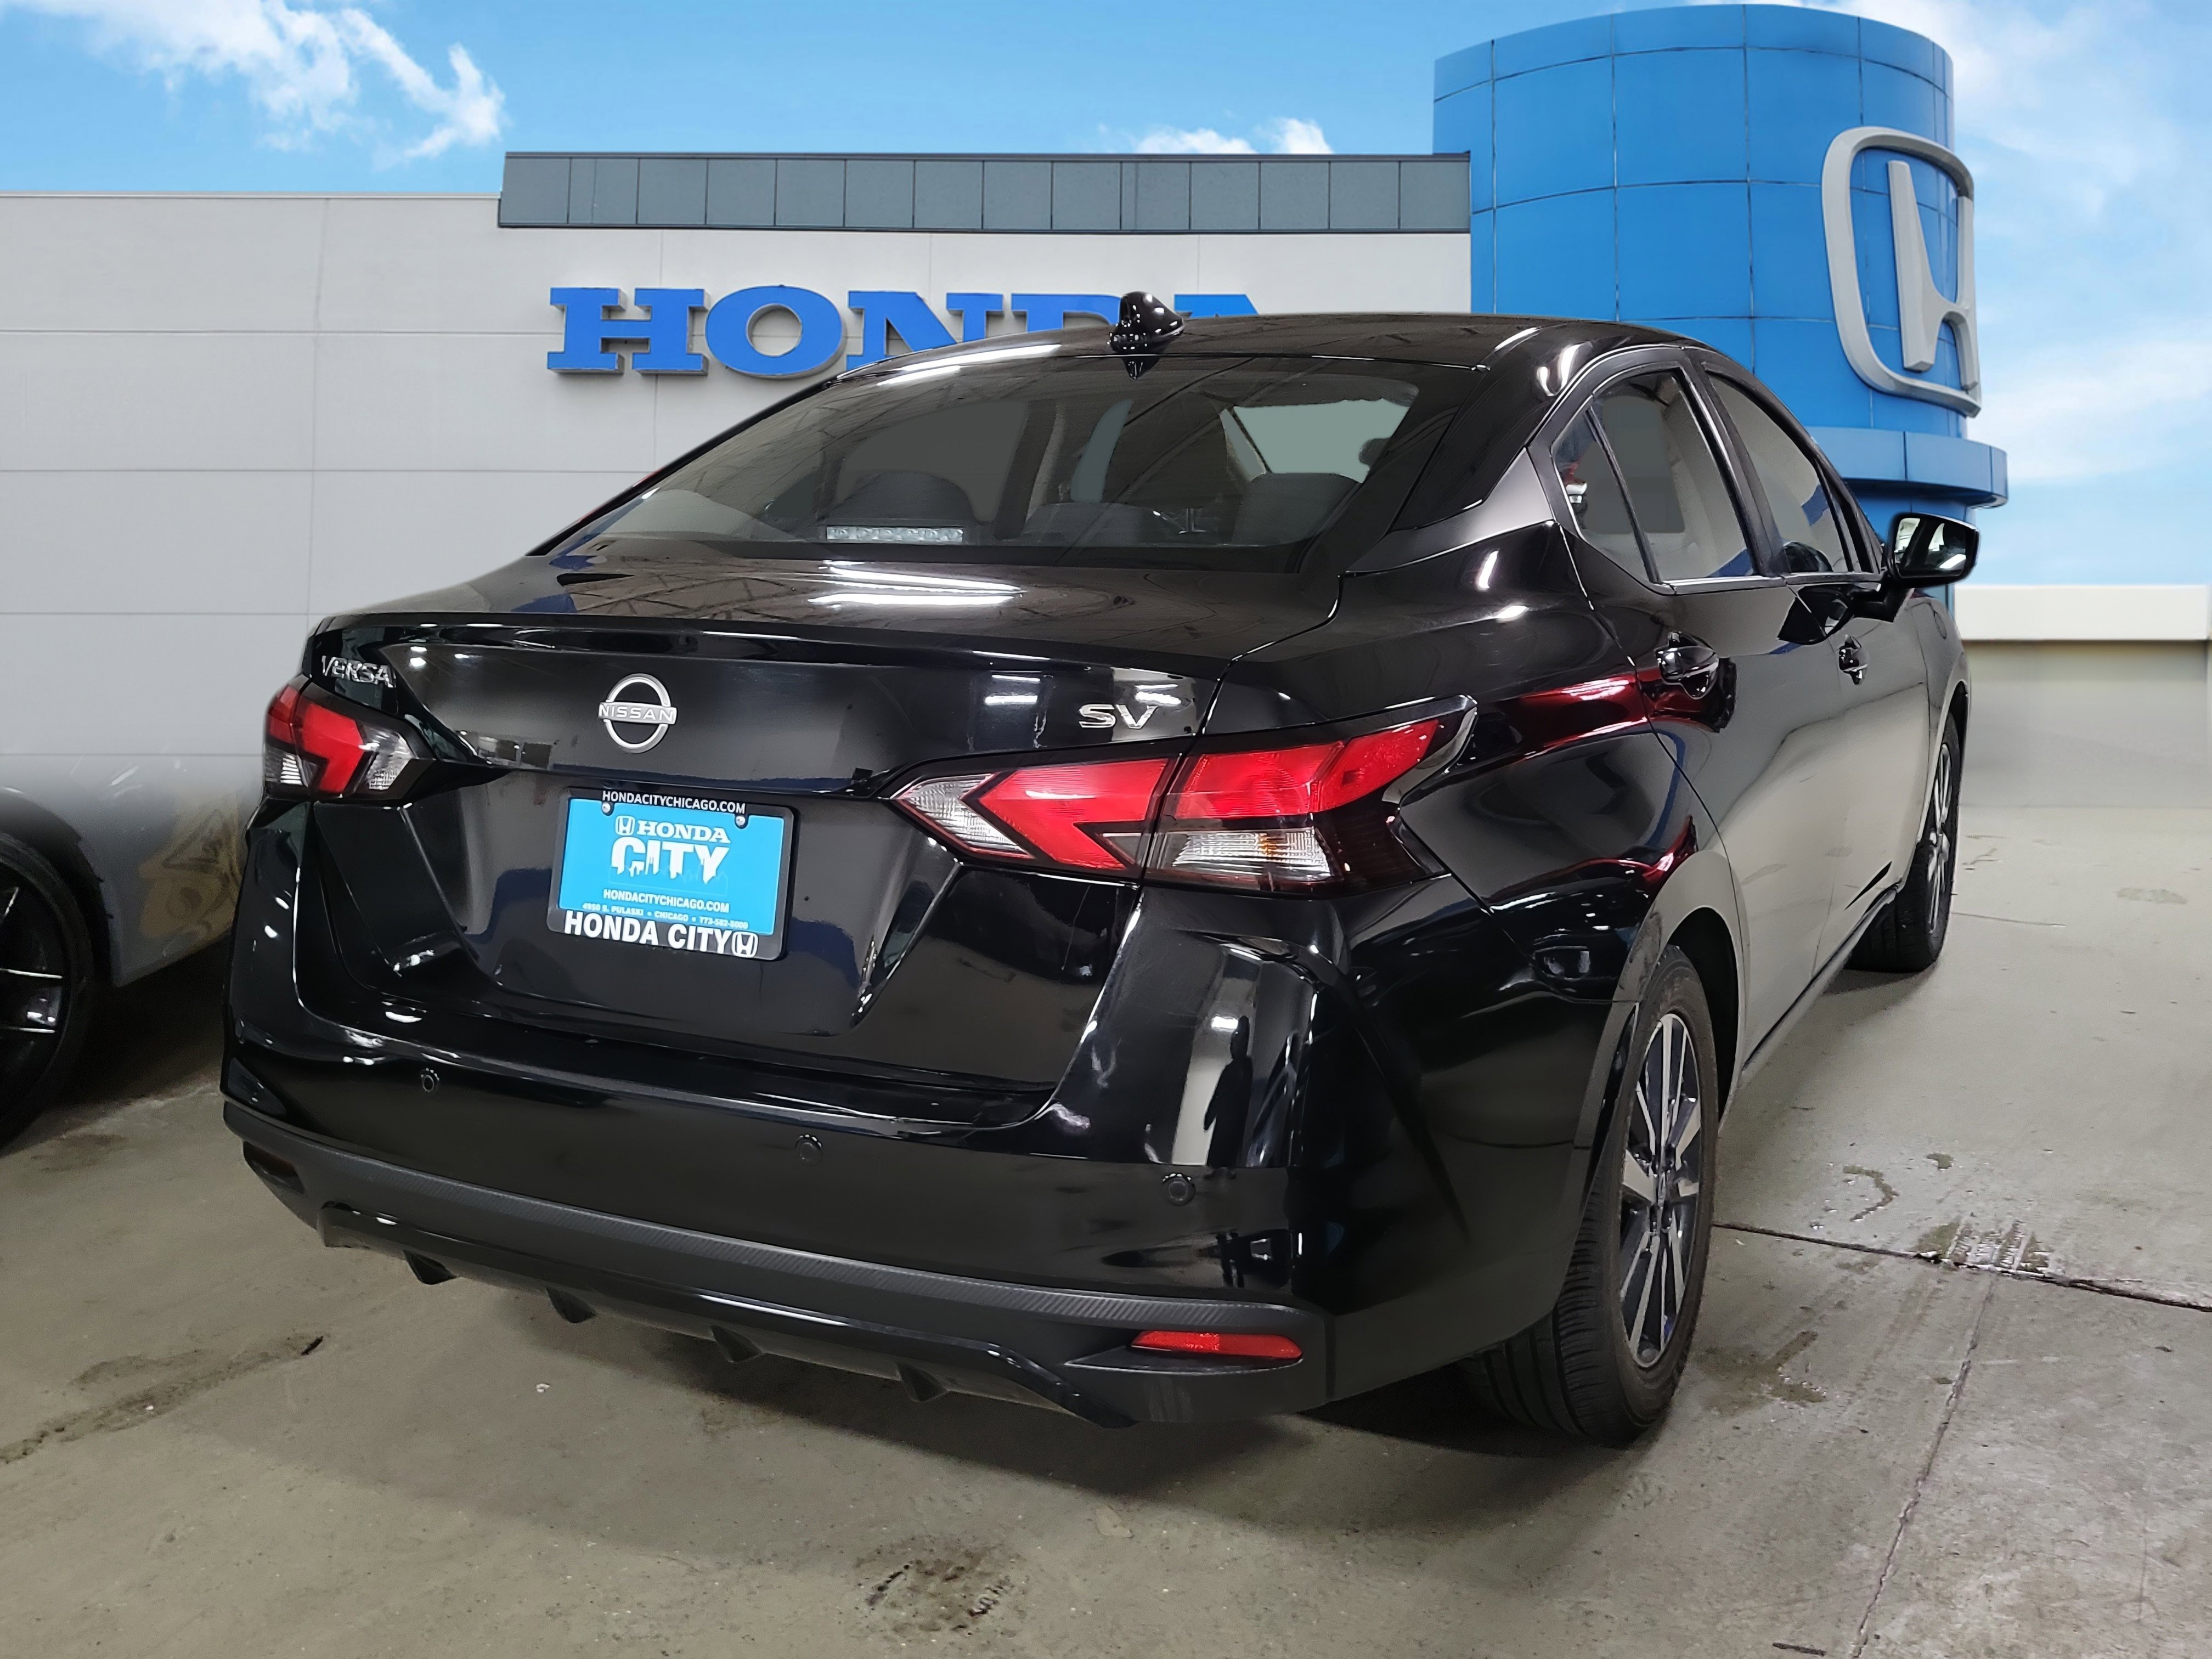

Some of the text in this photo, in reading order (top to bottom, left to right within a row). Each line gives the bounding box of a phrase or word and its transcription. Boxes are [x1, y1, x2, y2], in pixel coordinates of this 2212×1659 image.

[547, 284, 1259, 378] HON
[321, 655, 395, 687] VERSA
[598, 704, 673, 722] NISSAN
[1079, 703, 1159, 729] SV
[602, 790, 746, 815] HONDACITYCHICAGO.COM
[637, 820, 731, 844] HONDA
[611, 837, 730, 884] CITY
[603, 888, 730, 913] HONDACITYCHICAGO.COM
[653, 910, 689, 922] CHICAGO
[564, 910, 733, 955] HONDA CITY
